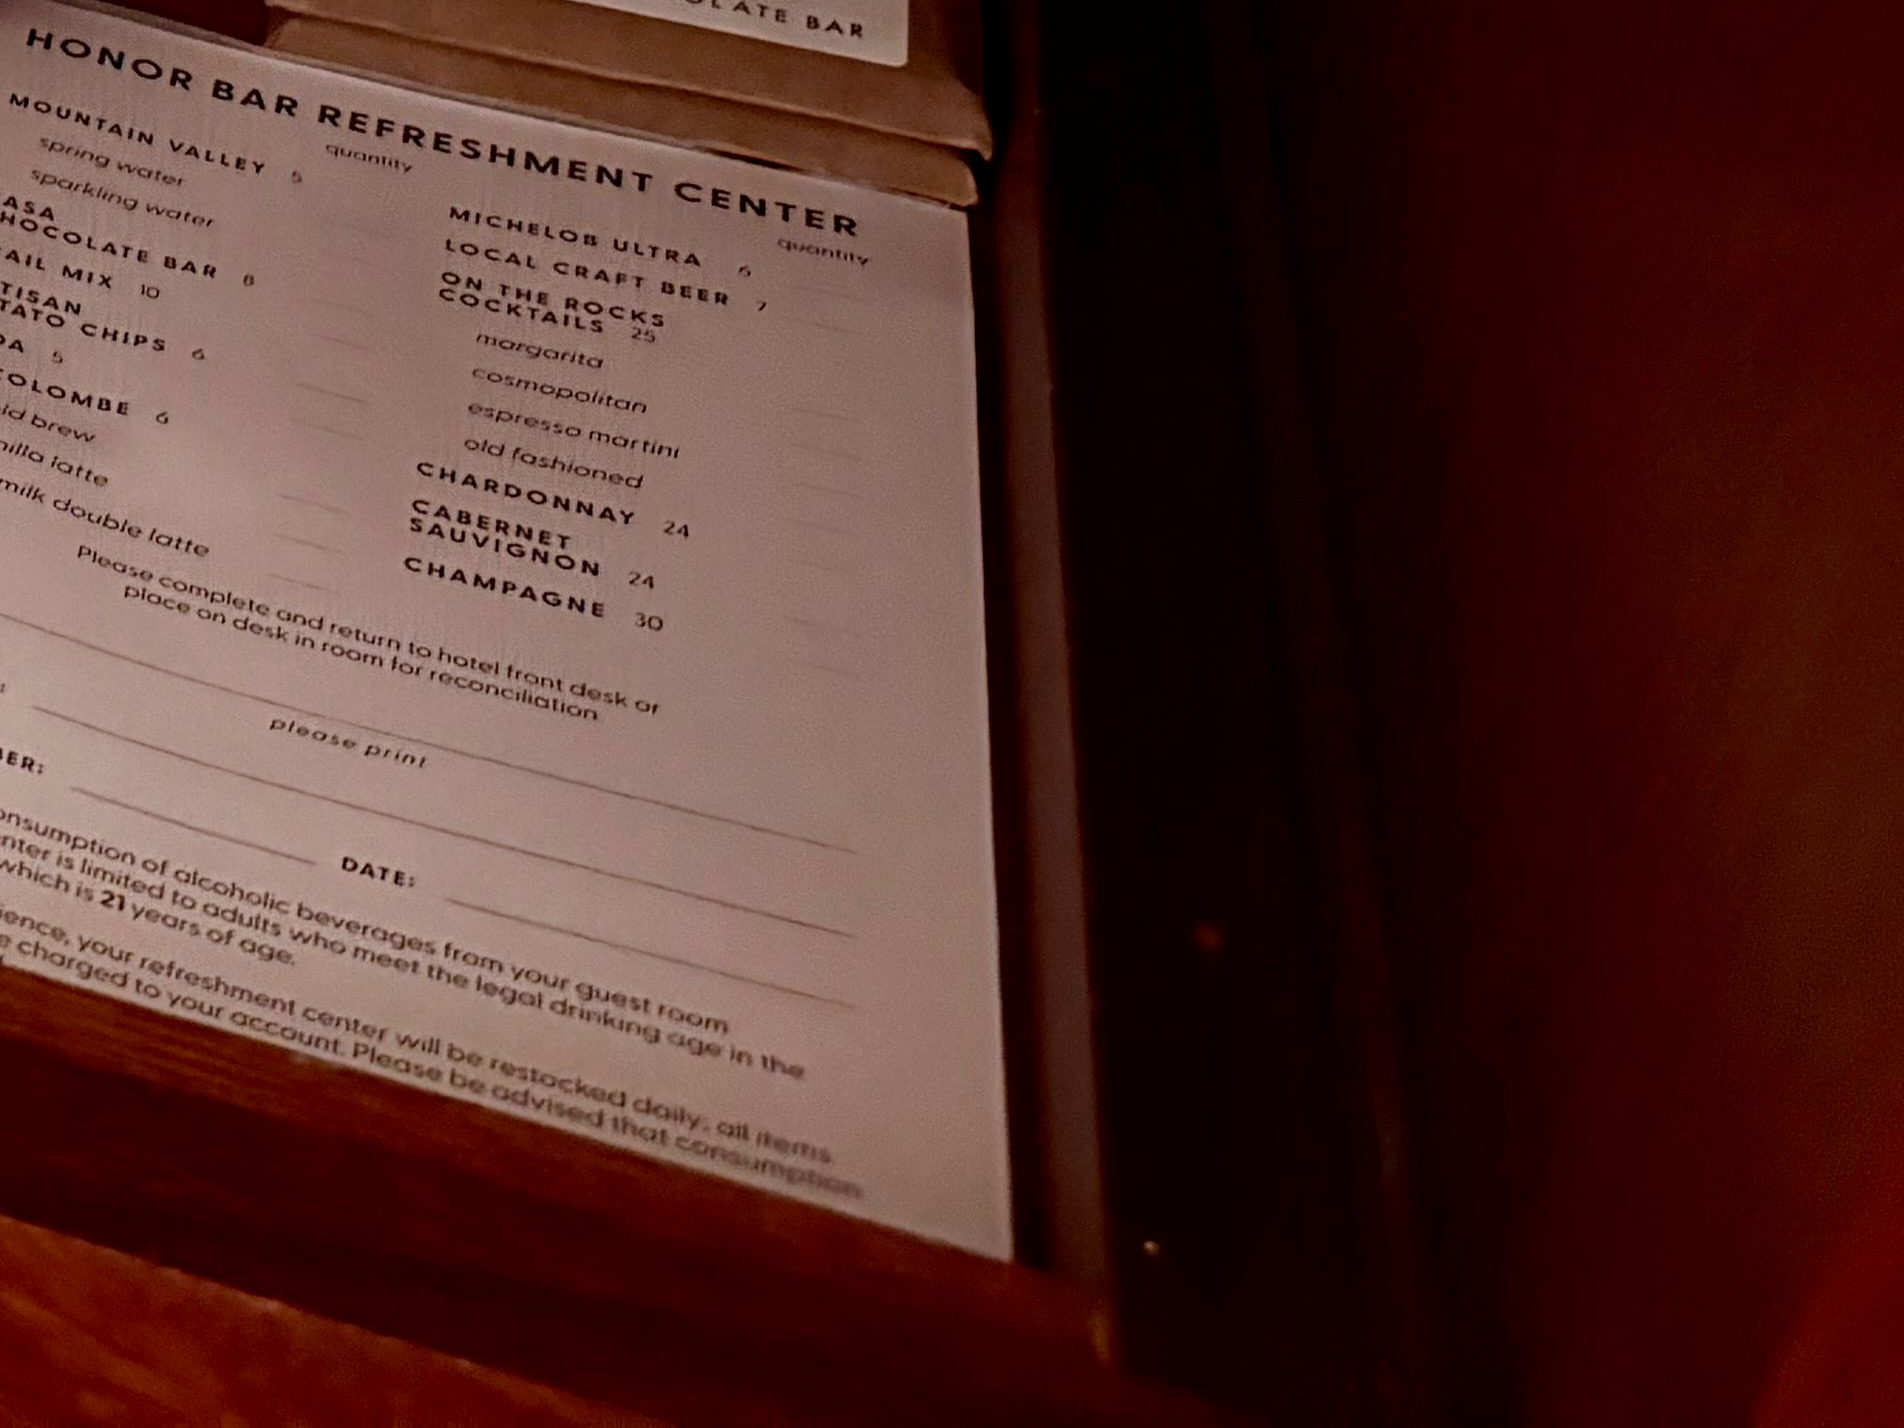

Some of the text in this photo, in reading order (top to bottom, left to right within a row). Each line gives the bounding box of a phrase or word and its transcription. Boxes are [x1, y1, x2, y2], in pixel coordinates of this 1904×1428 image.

[807, 16, 863, 38] BAR
[9, 93, 265, 174] MOUNTAIN VALLEY
[26, 28, 857, 236] HONOR BAR REFRESHMENT CENTER
[326, 144, 412, 173] quantity
[40, 137, 185, 187] spring water
[31, 169, 214, 228] sparkling water
[449, 206, 702, 267] MICHELOB ULTRA
[777, 238, 869, 267] quantity
[62, 264, 112, 289] MIX
[140, 284, 159, 299] 10
[163, 255, 218, 279] BAR
[446, 239, 730, 307] LOCAL CRAFT BEER
[439, 289, 655, 343] COCKTAILS 25
[441, 271, 665, 327] ON THE ROCKS
[80, 323, 165, 352] CHIPS
[476, 331, 604, 369] margarita
[472, 366, 648, 413] cosmopolitan
[31, 416, 95, 443] brew
[468, 402, 680, 460] espresso martini
[50, 455, 108, 488] latte
[464, 436, 643, 490] old fashioned
[412, 499, 571, 549] CABERNET
[416, 461, 690, 538] CHARDONNAY 24
[53, 498, 141, 538] double
[149, 527, 210, 557] latte
[409, 517, 655, 589] SAUVIGNON 24
[404, 557, 663, 631] CHAMPAGNE 30
[77, 545, 659, 716] Please complete and return to hotel front desk or
[124, 584, 598, 722] place on desk in room for reconciliation
[269, 716, 427, 769] please print
[342, 856, 415, 888] DATE:
[76, 884, 94, 902] is
[100, 889, 126, 912] 21
[131, 902, 200, 939] years
[206, 928, 233, 949] of
[239, 936, 296, 969] age.
